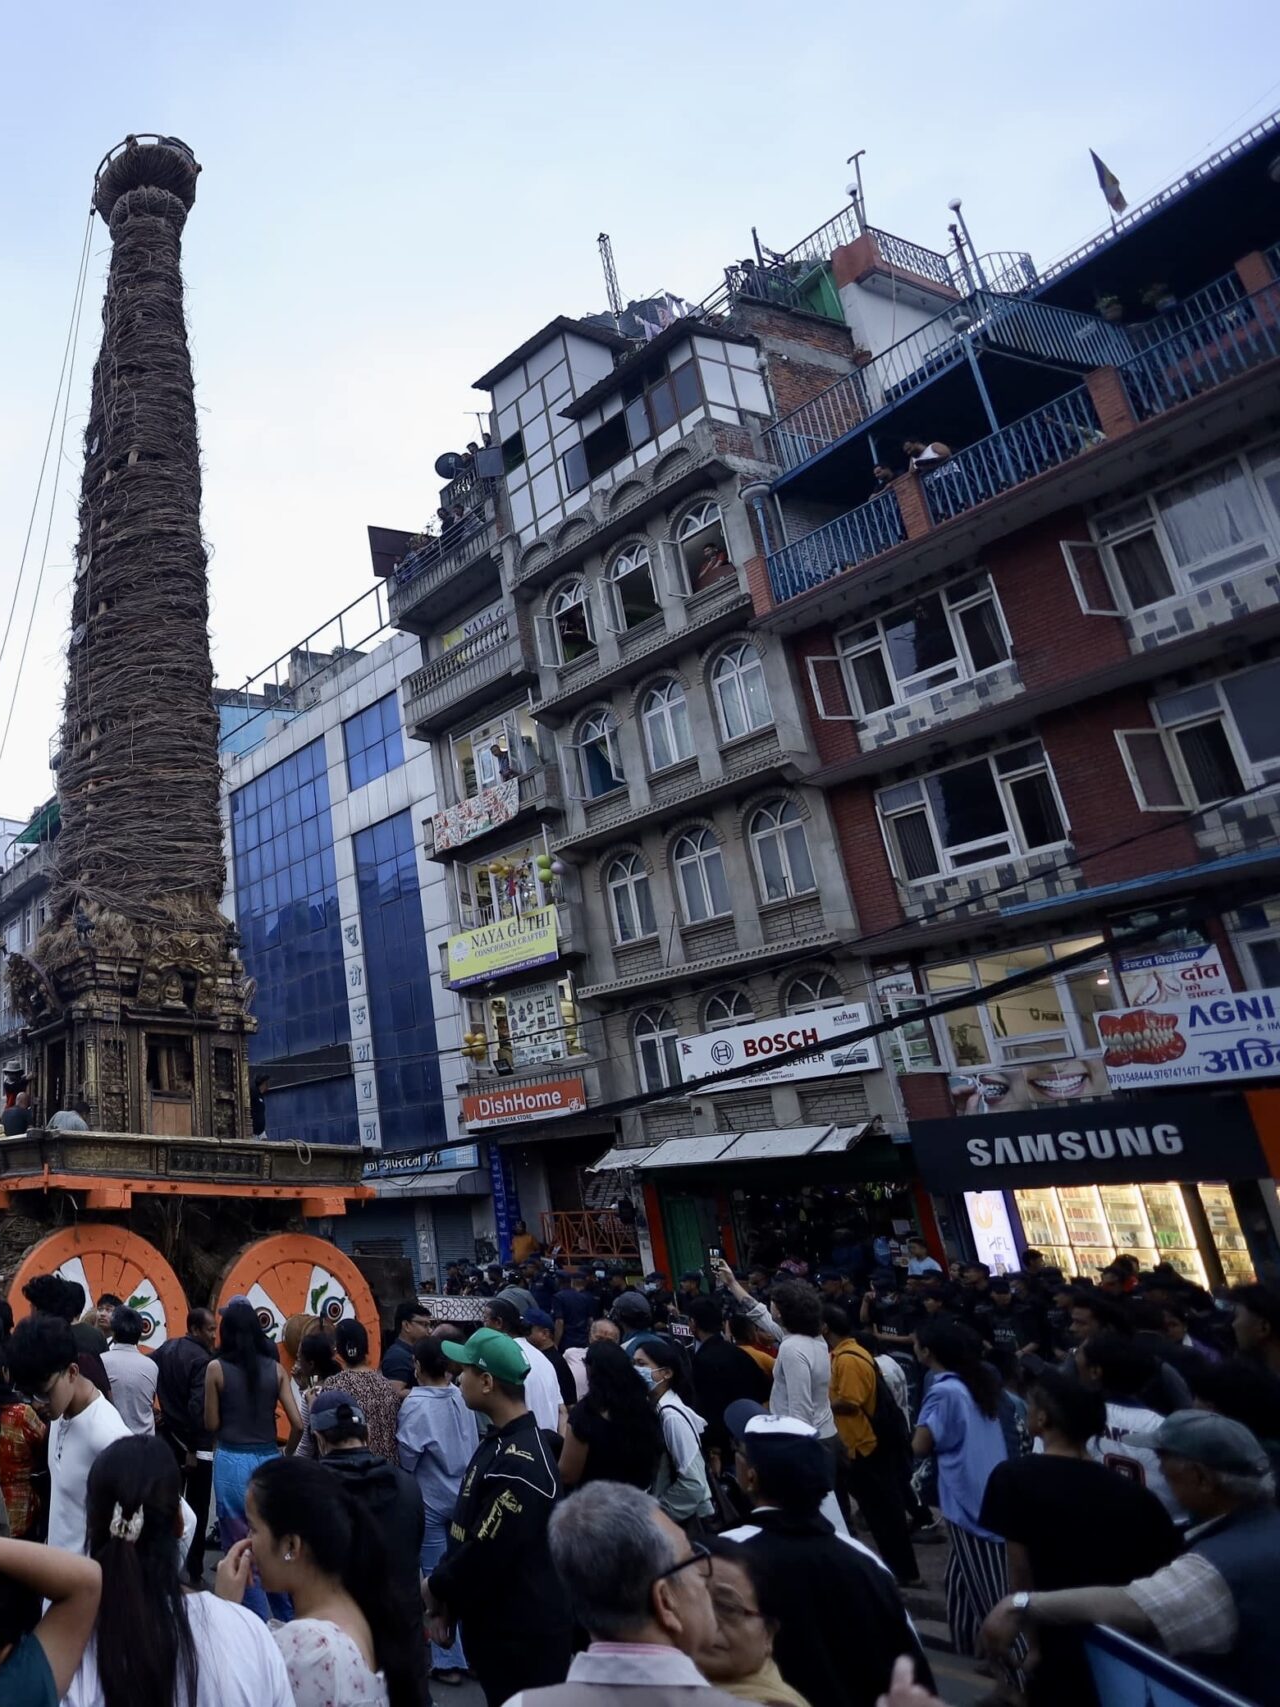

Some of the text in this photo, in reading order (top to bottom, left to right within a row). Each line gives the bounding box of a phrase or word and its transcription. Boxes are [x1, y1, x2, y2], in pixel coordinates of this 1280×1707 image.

[471, 911, 552, 949] NAYA GUTHI
[475, 939, 517, 958] CONSCIOUSLY
[518, 929, 549, 944] CRAFTED
[1179, 961, 1220, 982] दाँत
[1188, 995, 1276, 1028] AGNI
[743, 1027, 818, 1058] BOSCH
[479, 1091, 562, 1116] DishHome
[966, 1123, 1184, 1167] SAMSUNG
